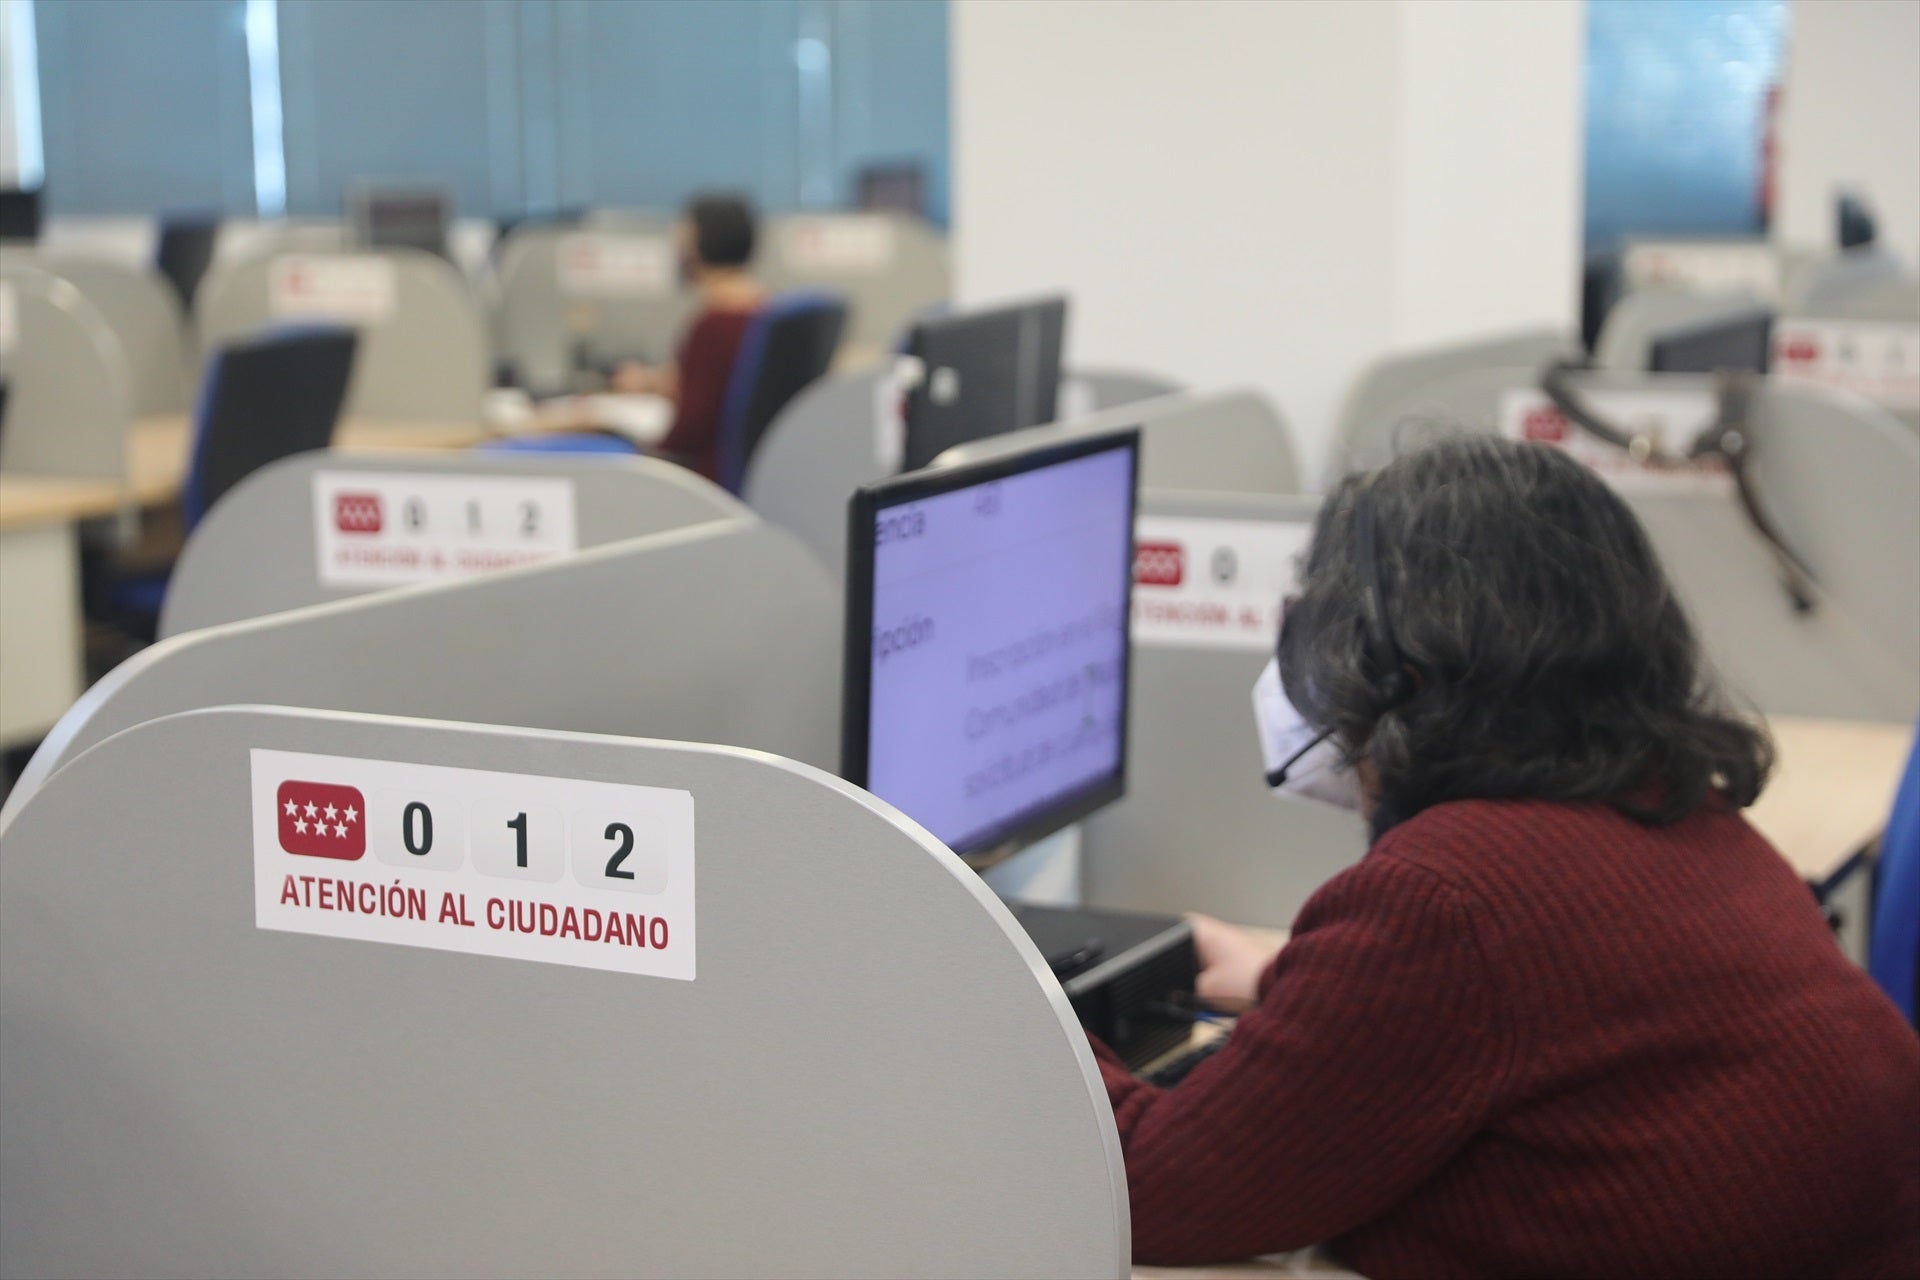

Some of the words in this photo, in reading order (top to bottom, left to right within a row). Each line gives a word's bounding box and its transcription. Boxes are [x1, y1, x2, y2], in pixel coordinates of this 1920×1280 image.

[402, 801, 434, 856] 0
[506, 811, 528, 868] 1
[603, 822, 636, 881] 2
[279, 874, 427, 922] ATENCIÓN
[438, 892, 475, 928] AL
[486, 897, 670, 951] CIUDADANO
